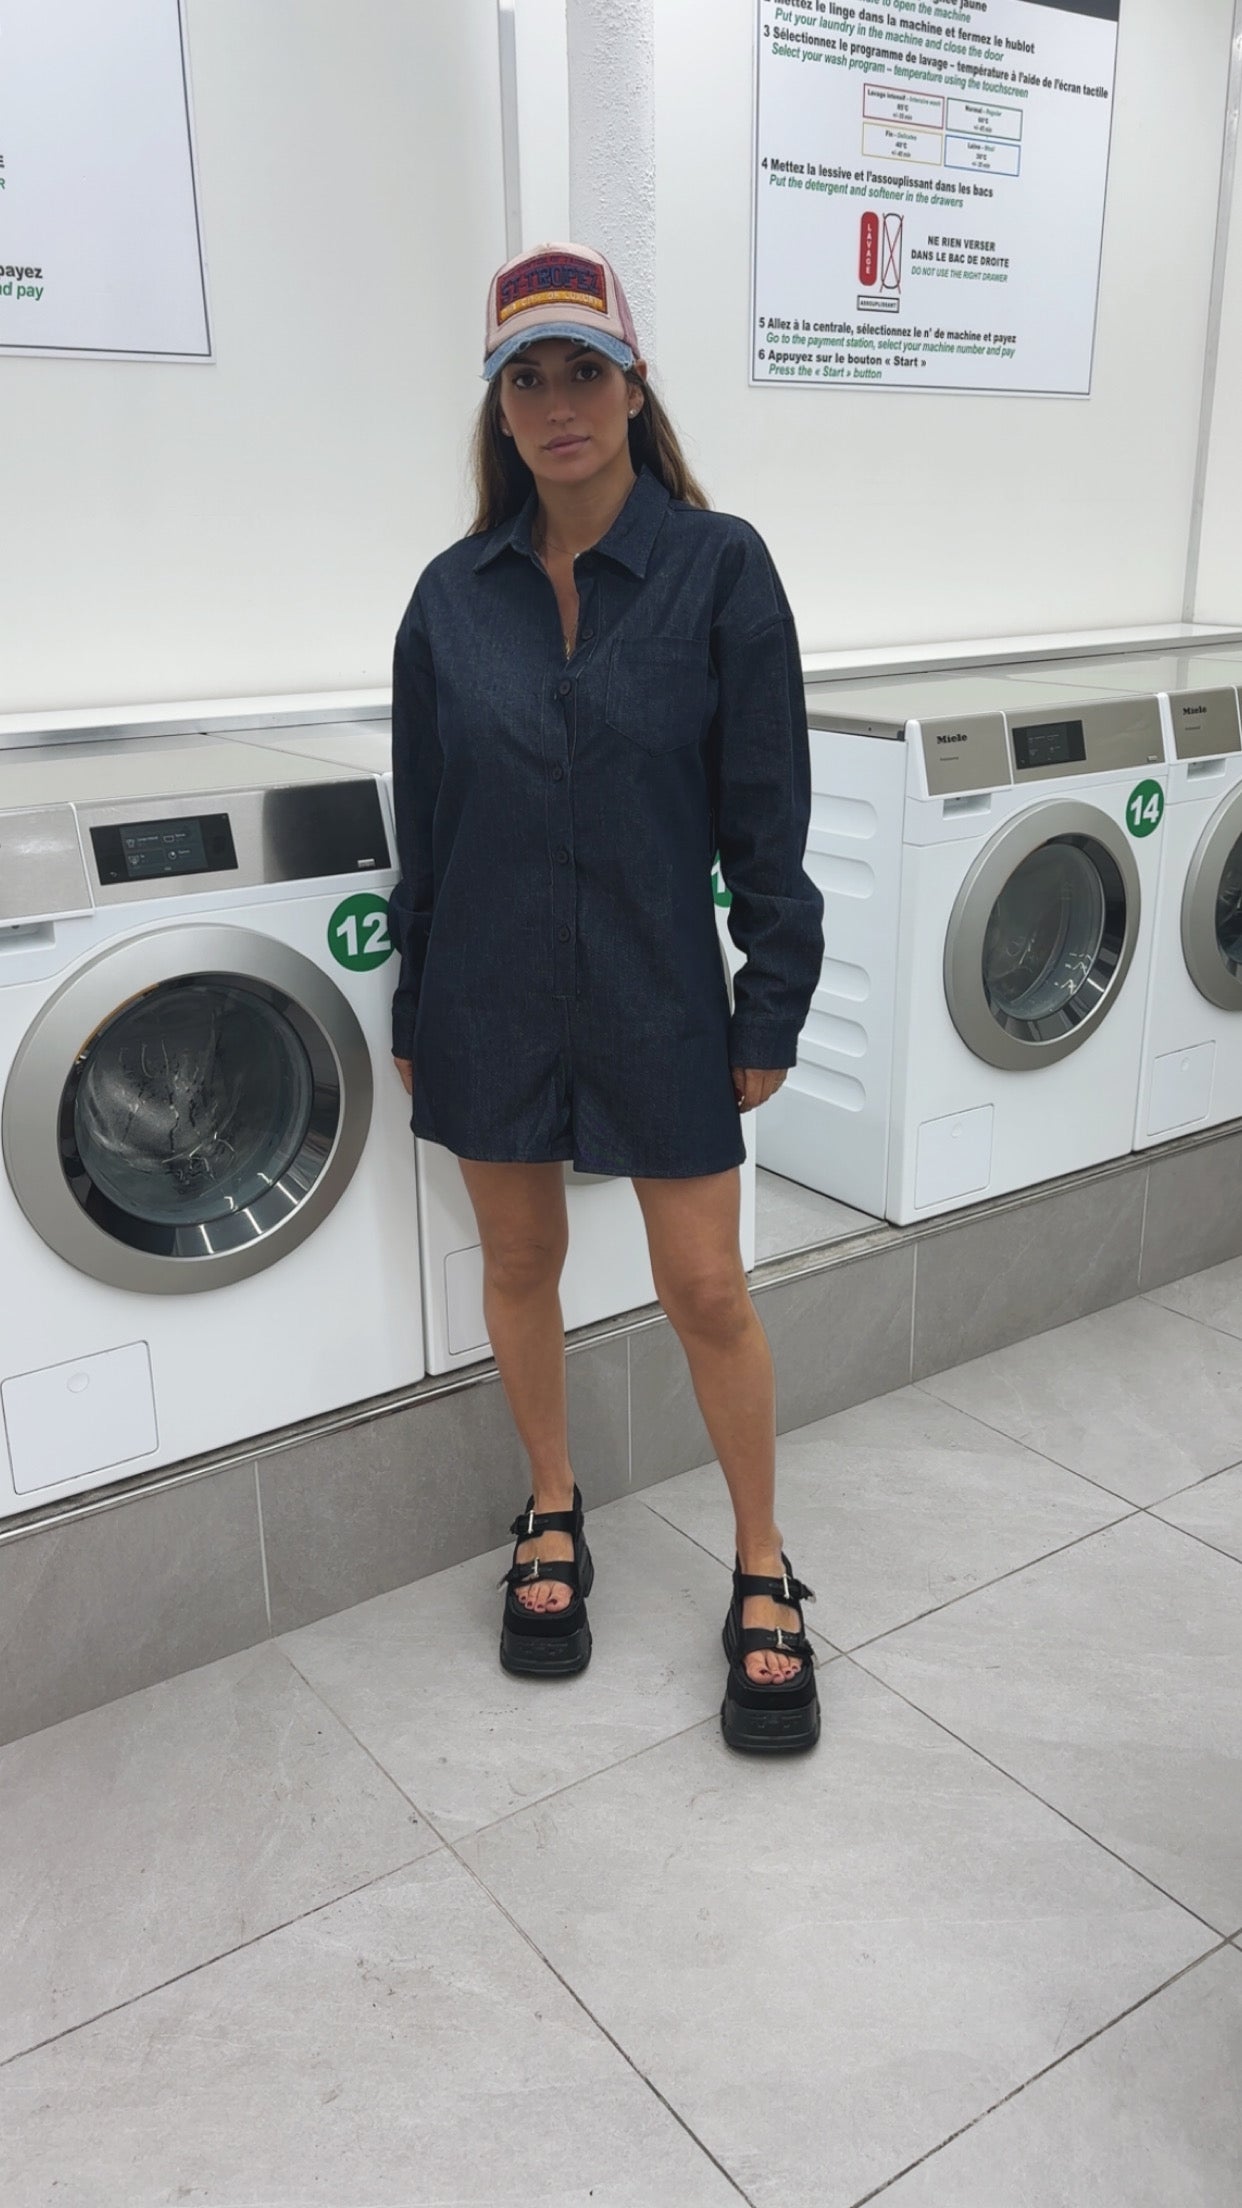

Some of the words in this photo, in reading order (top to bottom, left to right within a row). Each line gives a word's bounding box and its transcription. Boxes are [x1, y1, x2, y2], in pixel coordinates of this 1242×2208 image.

[893, 0, 916, 12] open
[918, 2, 932, 15] the
[934, 7, 971, 23] machine
[959, 0, 987, 12] jaune
[775, 7, 792, 22] Put
[794, 13, 816, 26] your
[819, 16, 855, 37] laundry
[857, 23, 866, 36] in
[868, 25, 883, 39] the
[885, 31, 924, 47] machine
[925, 38, 941, 50] and
[944, 41, 967, 56] close
[968, 45, 982, 58] the
[984, 48, 1004, 62] door
[816, 0, 826, 13] le
[829, 2, 855, 20] linge
[858, 8, 884, 24] dans
[887, 13, 896, 26] la
[900, 18, 942, 36] machine
[945, 27, 955, 38] et
[958, 28, 991, 45] fermez
[993, 35, 1003, 47] le
[1005, 37, 1035, 54] hublot
[763, 24, 770, 37] 3
[773, 26, 837, 50] Sélectionnez
[839, 38, 848, 51] le
[850, 43, 903, 61] programme
[905, 51, 917, 63] de
[919, 53, 948, 71] lavage
[957, 61, 1009, 80] température
[1010, 70, 1016, 81] à
[1042, 77, 1052, 89] de
[1083, 84, 1108, 99] tactile
[771, 42, 800, 59] Select
[801, 49, 822, 62] your
[824, 53, 847, 67] wash
[848, 58, 885, 73] program
[894, 65, 943, 83] temperature
[944, 75, 967, 90] using
[968, 78, 980, 90] the
[982, 81, 1029, 98] touchscreen
[761, 157, 768, 169] 4
[771, 158, 805, 174] Mettez
[807, 163, 816, 176] la
[819, 164, 852, 179] lessive
[854, 171, 864, 181] et
[935, 179, 956, 193] dans
[958, 183, 971, 195] les
[973, 184, 993, 198] bacs
[769, 174, 786, 187] Put
[788, 176, 803, 189] the
[805, 179, 848, 196] detergent
[849, 185, 867, 197] and
[868, 186, 904, 201] softener
[905, 190, 913, 202] in
[915, 191, 929, 203] the
[930, 194, 963, 208] drawers
[927, 235, 939, 246] NE
[942, 237, 961, 248] RIEN
[964, 239, 995, 252] VERSER
[911, 249, 934, 261] DANS
[936, 252, 946, 262] LE
[949, 253, 965, 264] BAC
[967, 255, 977, 265] DE
[980, 256, 1009, 268] DROITE
[911, 266, 920, 276] DO
[922, 267, 935, 276] NOT
[936, 268, 950, 278] USE
[950, 268, 962, 279] THE
[962, 270, 982, 280] RIGHT
[982, 272, 1008, 283] DRAWER
[16, 284, 44, 301] pay
[759, 317, 765, 328] 5
[767, 317, 791, 331] Allez
[793, 318, 799, 330] à
[802, 320, 810, 331] la
[813, 321, 854, 336] centrale,
[856, 323, 911, 337] sélectionnez
[913, 326, 922, 338] le
[934, 328, 945, 339] de
[947, 330, 981, 341] machine
[983, 332, 991, 342] et
[993, 334, 1016, 345] payez
[758, 349, 765, 360] 6
[768, 350, 813, 364] Appuyez
[816, 354, 832, 363] sur
[835, 353, 844, 363] le
[847, 354, 882, 365] bouton
[893, 355, 918, 367] Start
[766, 332, 779, 344] Go
[781, 333, 790, 344] to
[792, 334, 806, 344] the
[807, 337, 845, 349] payment
[846, 337, 875, 350] station,
[878, 339, 902, 350] select
[902, 342, 921, 353] your
[922, 342, 955, 353] machine
[956, 344, 985, 355] number
[986, 345, 1001, 355] and
[1001, 348, 1016, 359] pay
[769, 363, 795, 376] Press
[798, 364, 813, 376] the
[822, 365, 844, 377] Start
[853, 368, 882, 379] button
[1182, 706, 1207, 716] Miele
[936, 733, 968, 745] Miele
[1130, 793, 1160, 826] 14
[336, 911, 391, 957] 12
